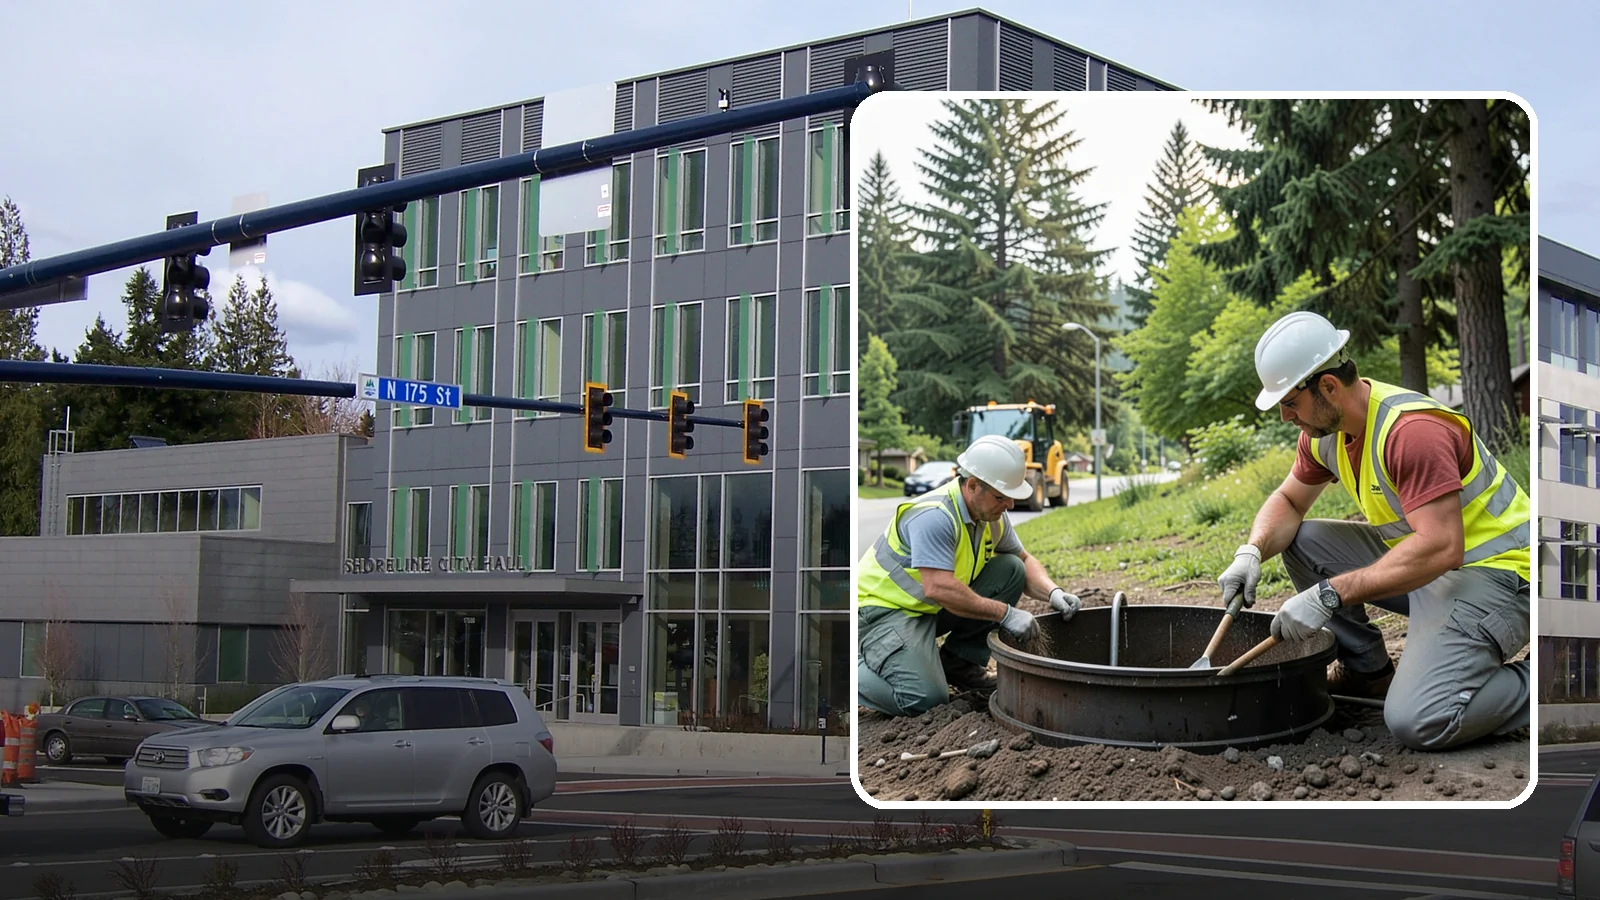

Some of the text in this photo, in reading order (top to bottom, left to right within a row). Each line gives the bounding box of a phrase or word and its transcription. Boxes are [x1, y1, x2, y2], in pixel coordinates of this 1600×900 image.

[387, 380, 452, 406] N 175 St
[344, 555, 525, 574] SHORELINE CITY HALL
